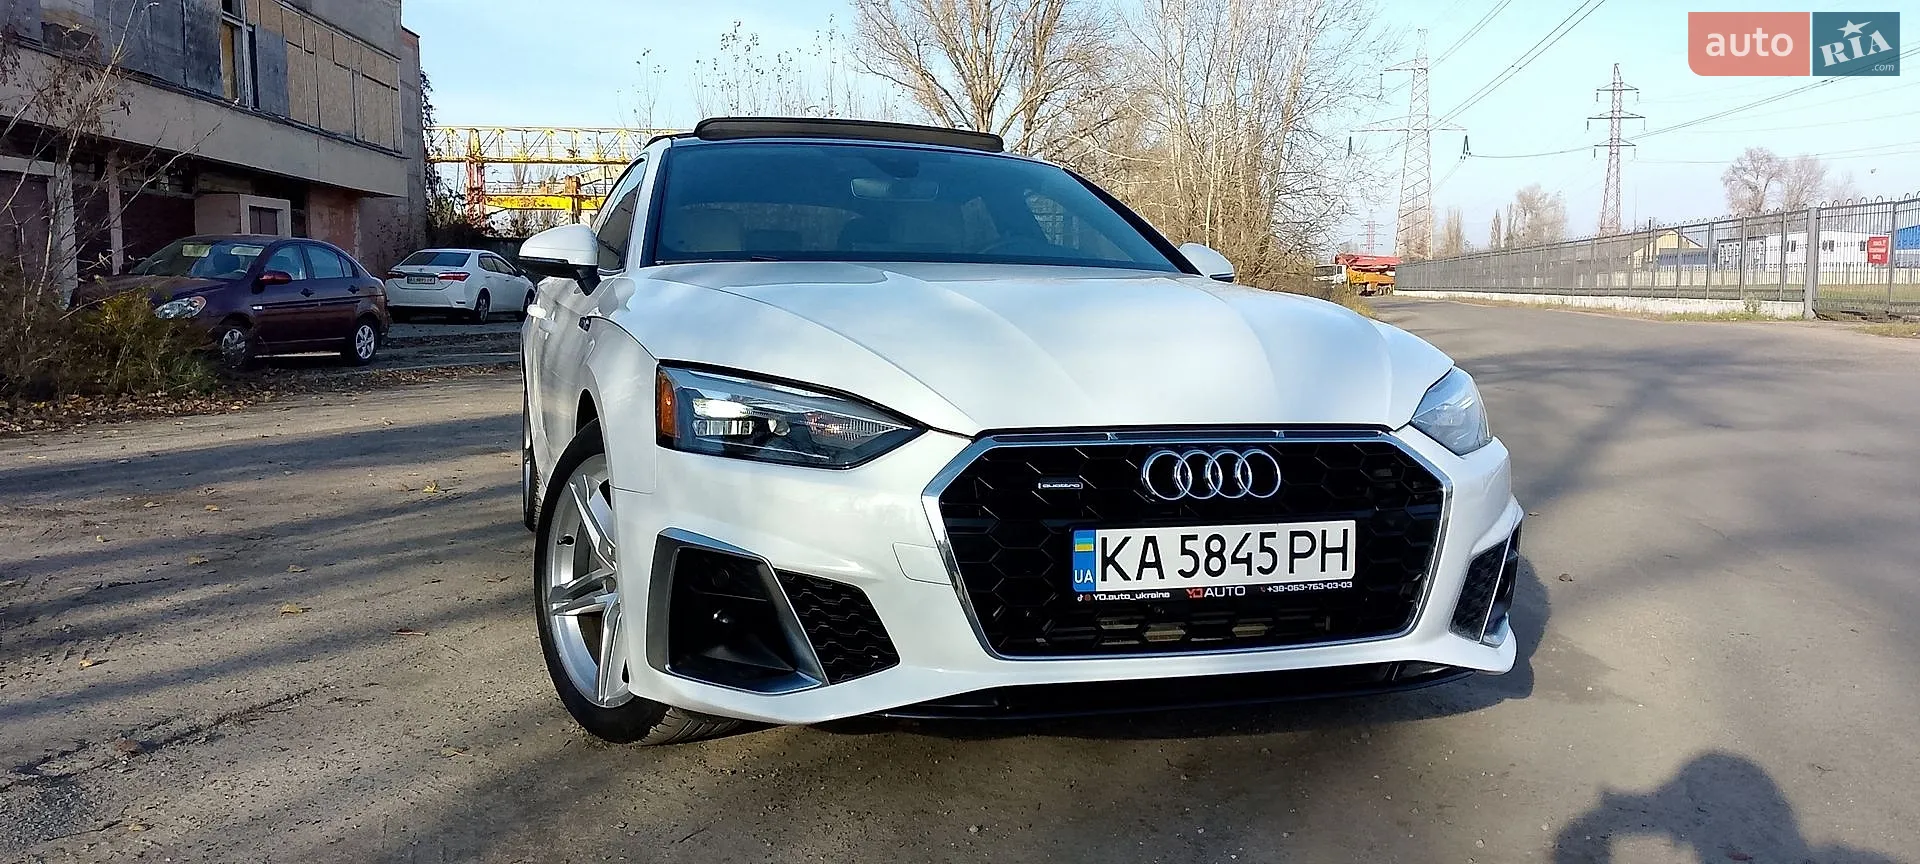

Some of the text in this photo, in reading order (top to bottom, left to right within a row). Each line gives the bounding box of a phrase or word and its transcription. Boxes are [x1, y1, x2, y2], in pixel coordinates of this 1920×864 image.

[1100, 528, 1348, 582] KA 5845 PH
[1074, 569, 1093, 583] UA
